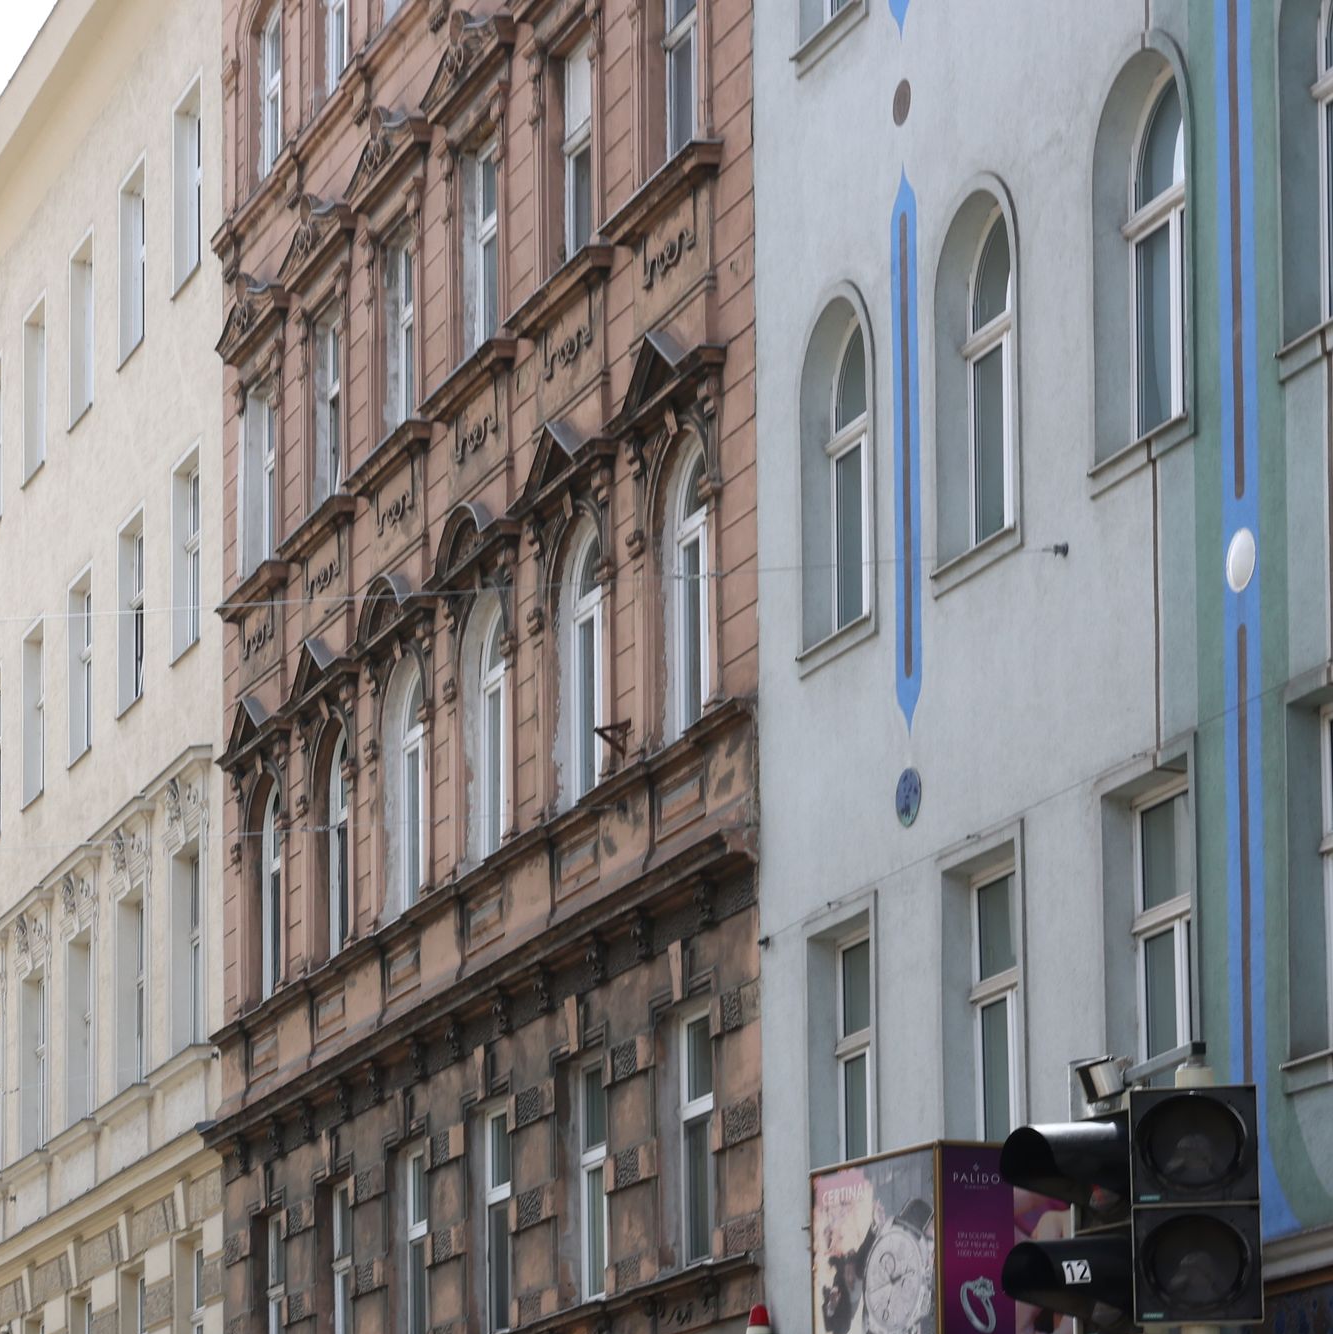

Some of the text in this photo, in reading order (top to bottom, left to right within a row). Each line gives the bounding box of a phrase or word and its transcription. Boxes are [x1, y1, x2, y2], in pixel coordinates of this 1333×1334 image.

[953, 1172, 1000, 1185] PALIDO
[822, 1183, 865, 1204] CERTINA
[1066, 1262, 1090, 1282] 12
